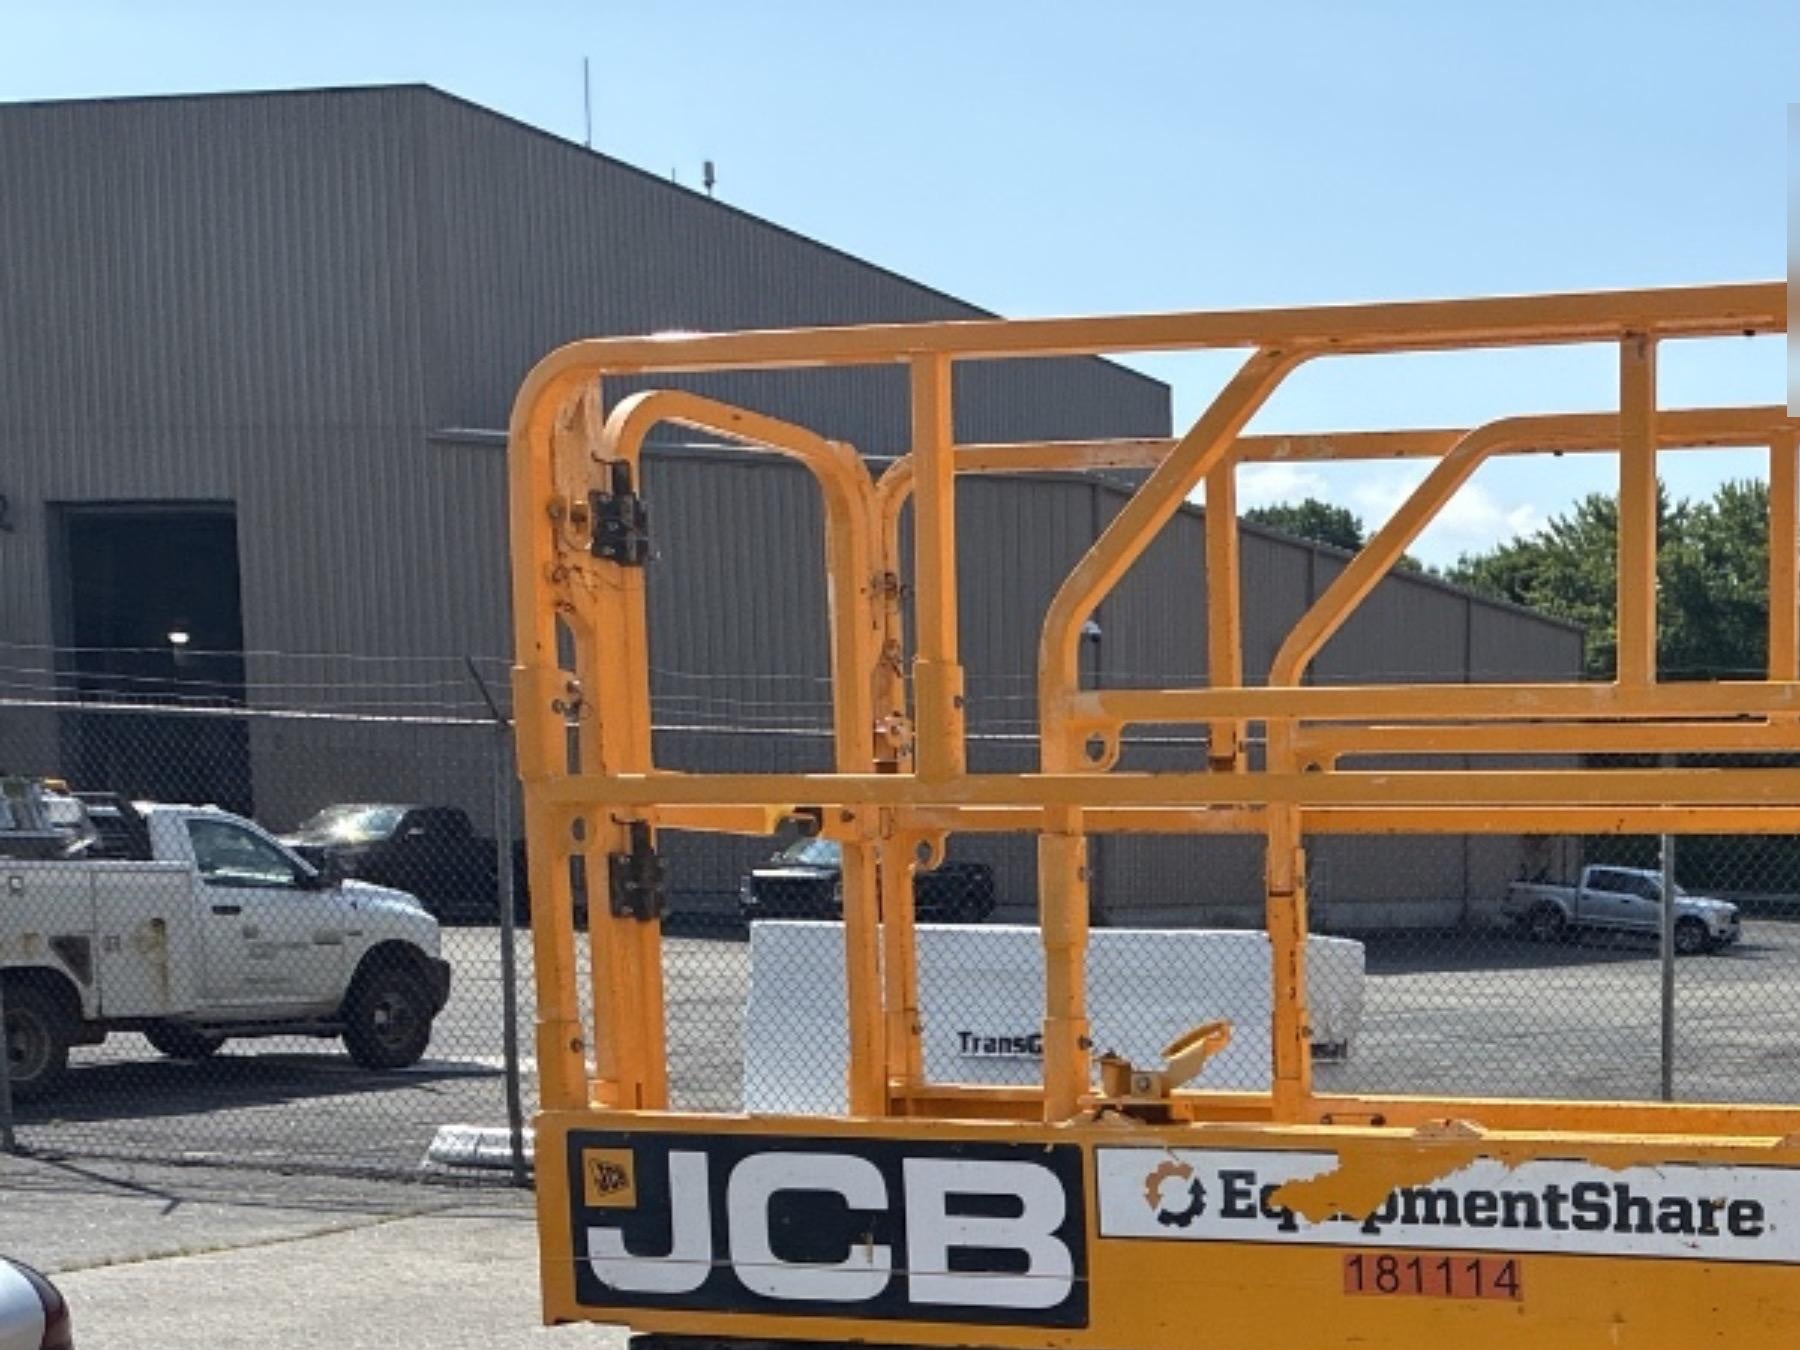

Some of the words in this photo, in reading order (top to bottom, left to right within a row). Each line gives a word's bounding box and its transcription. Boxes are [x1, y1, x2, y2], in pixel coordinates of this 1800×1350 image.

[957, 1031, 1043, 1053] TransG
[588, 1150, 1075, 1310] JCB
[1347, 1254, 1520, 1298] 181114
